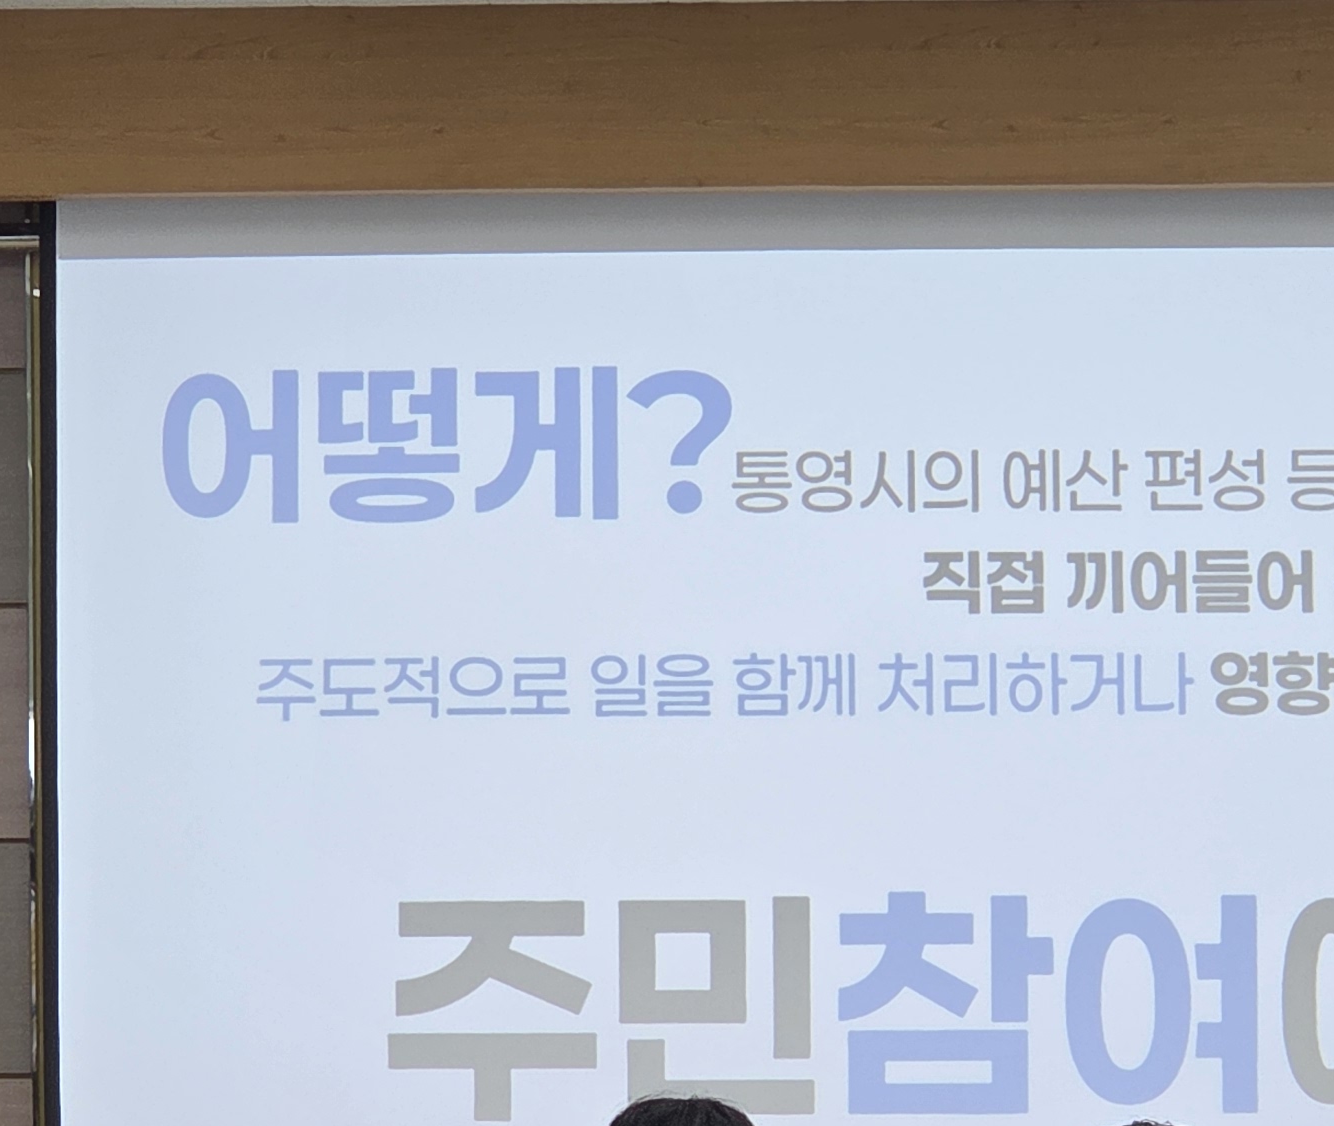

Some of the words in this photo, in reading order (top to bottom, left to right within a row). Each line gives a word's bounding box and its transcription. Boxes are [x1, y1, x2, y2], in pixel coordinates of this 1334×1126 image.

[162, 366, 733, 523] 어떻게?
[732, 450, 979, 513] 통영시의
[1003, 449, 1128, 512] 예산
[1145, 449, 1264, 511] 편성
[923, 551, 1044, 614] 직접
[1067, 550, 1314, 613] 끼어들어
[256, 656, 570, 721] 주도적으로
[591, 654, 713, 717] 일을
[733, 653, 855, 716] 함께
[878, 652, 1194, 716] 처리하거나
